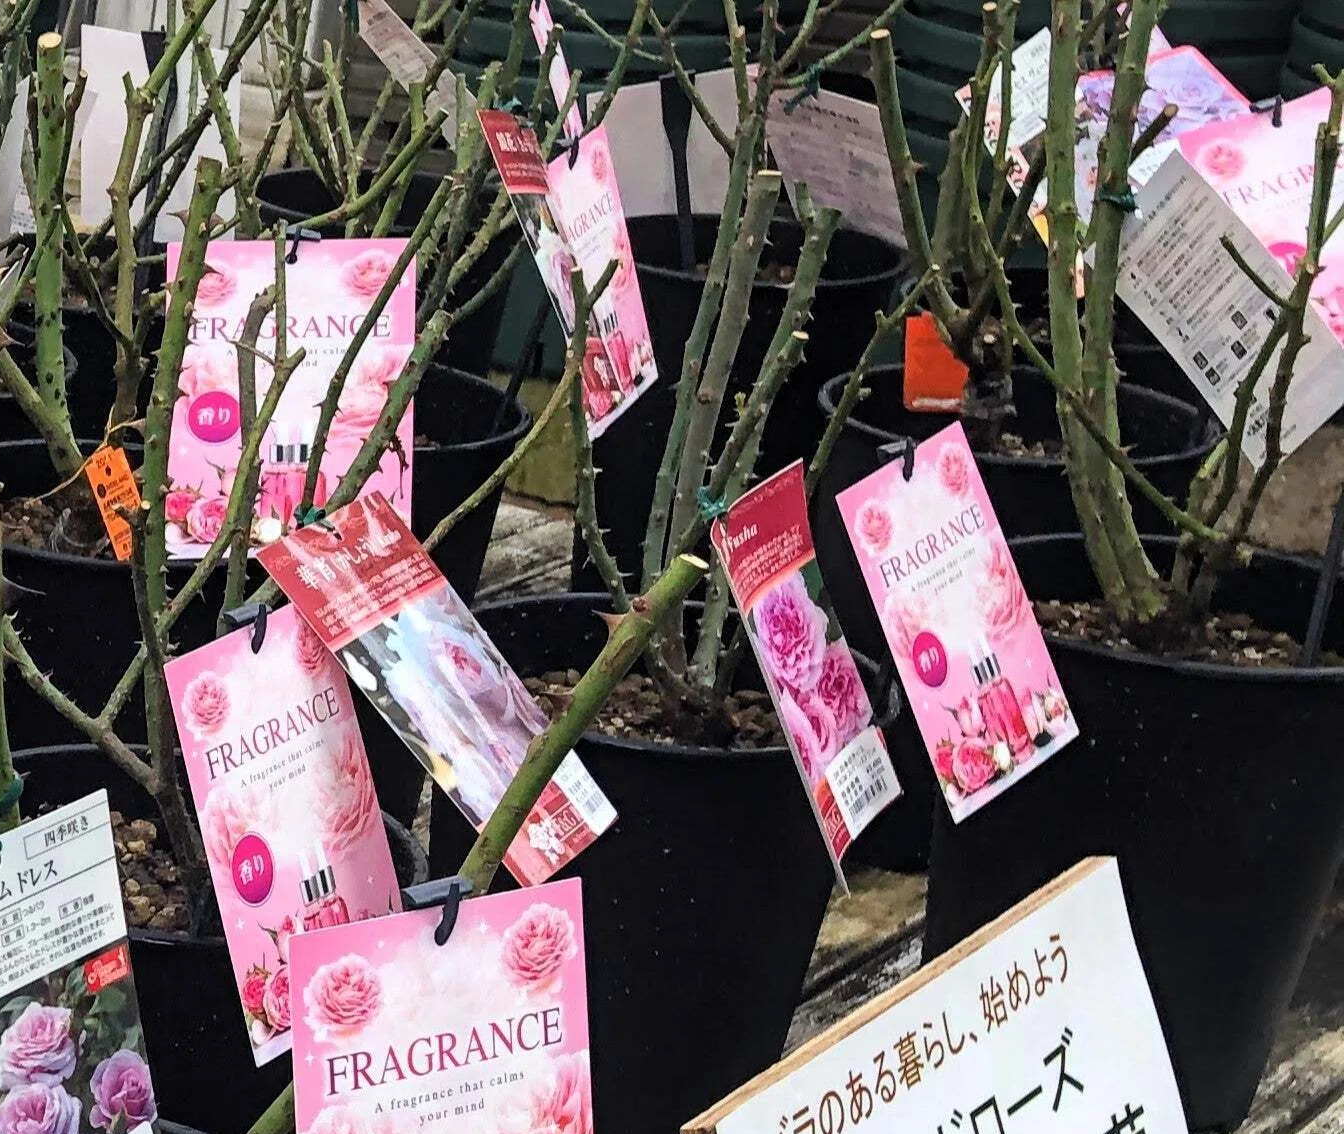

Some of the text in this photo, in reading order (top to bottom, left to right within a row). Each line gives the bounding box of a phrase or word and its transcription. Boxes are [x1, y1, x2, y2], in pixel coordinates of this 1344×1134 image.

[567, 193, 616, 242] AGRANCE
[879, 503, 985, 588] FRAGRANCE
[205, 686, 340, 781] FRAGRANCE
[44, 814, 89, 848] 四季咲き
[325, 1007, 563, 1096] FRAGRANCE
[390, 1087, 454, 1111] fragrance
[459, 1080, 484, 1095] that
[490, 1071, 525, 1087] calms
[419, 1100, 485, 1127] your mind
